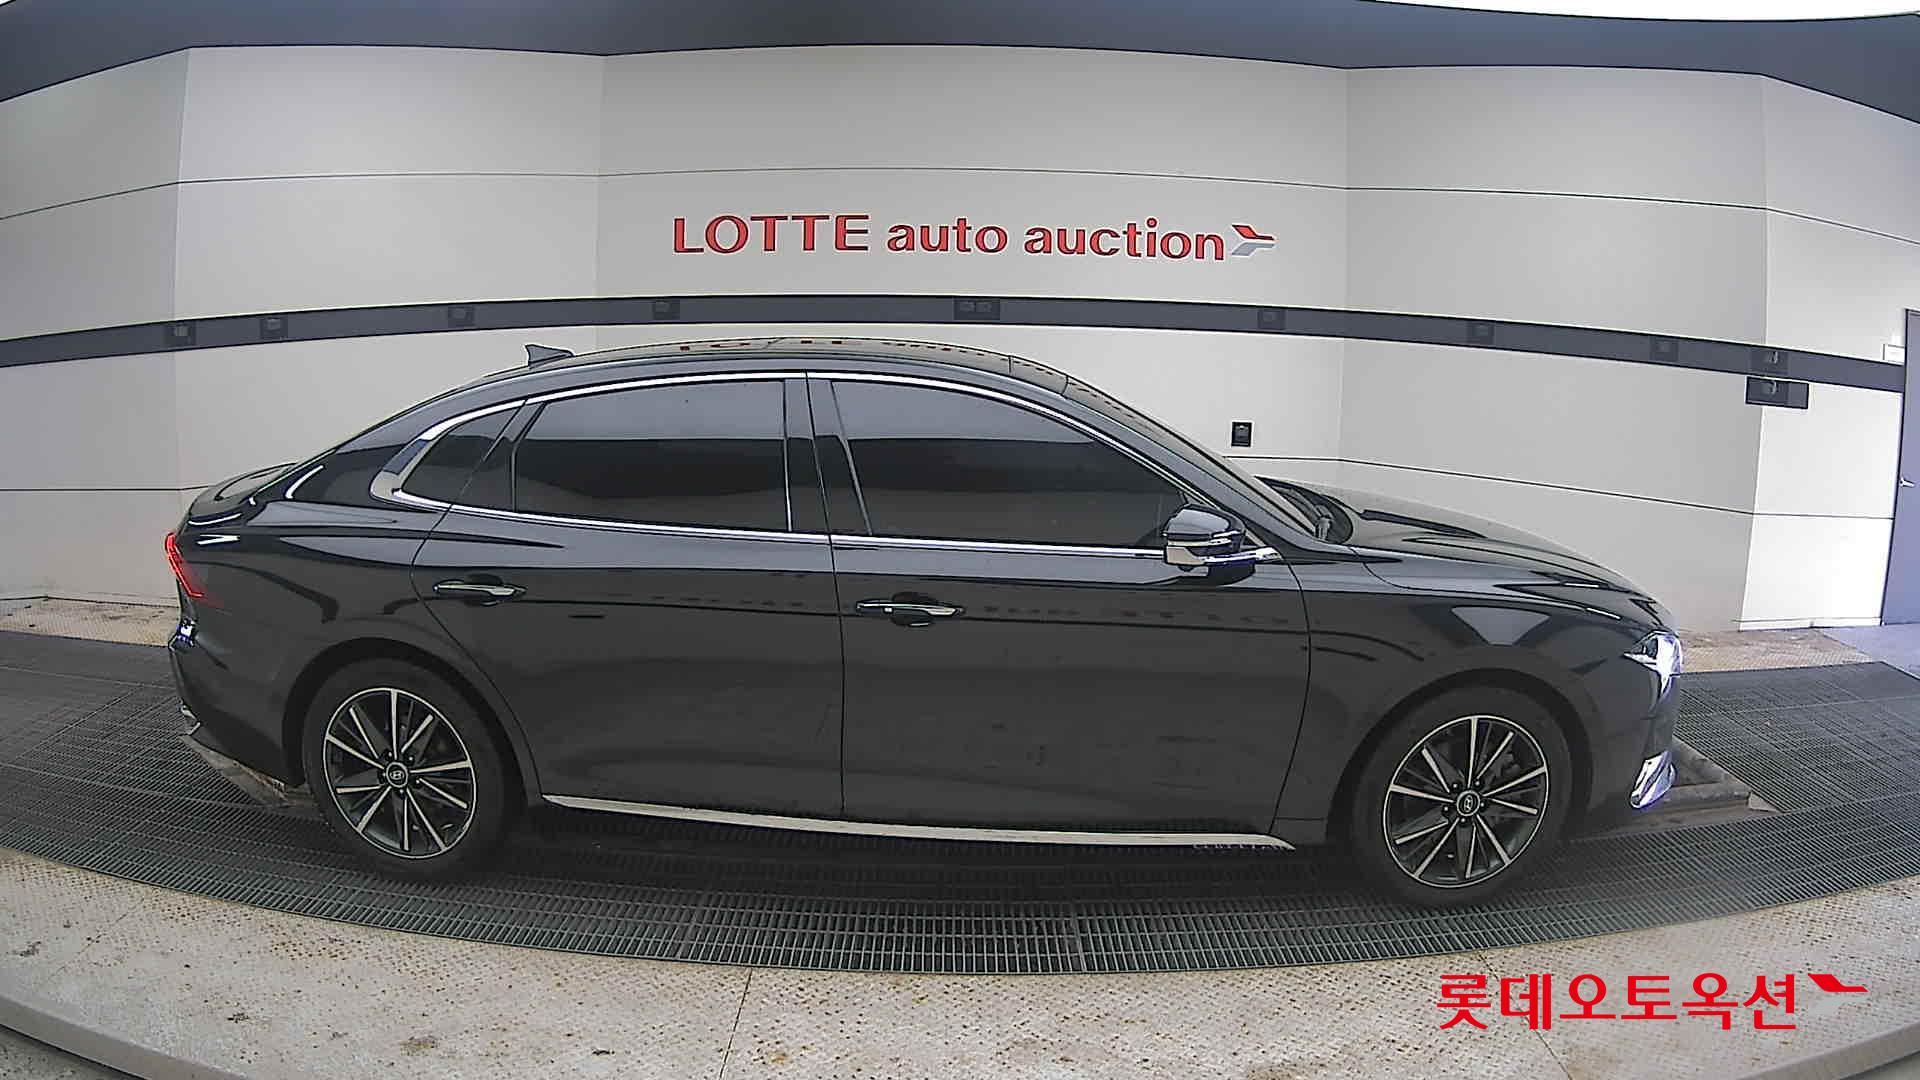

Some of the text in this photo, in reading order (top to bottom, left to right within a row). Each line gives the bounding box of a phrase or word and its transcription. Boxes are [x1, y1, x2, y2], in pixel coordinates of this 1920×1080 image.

[673, 214, 1225, 261] LOTTE auto auction
